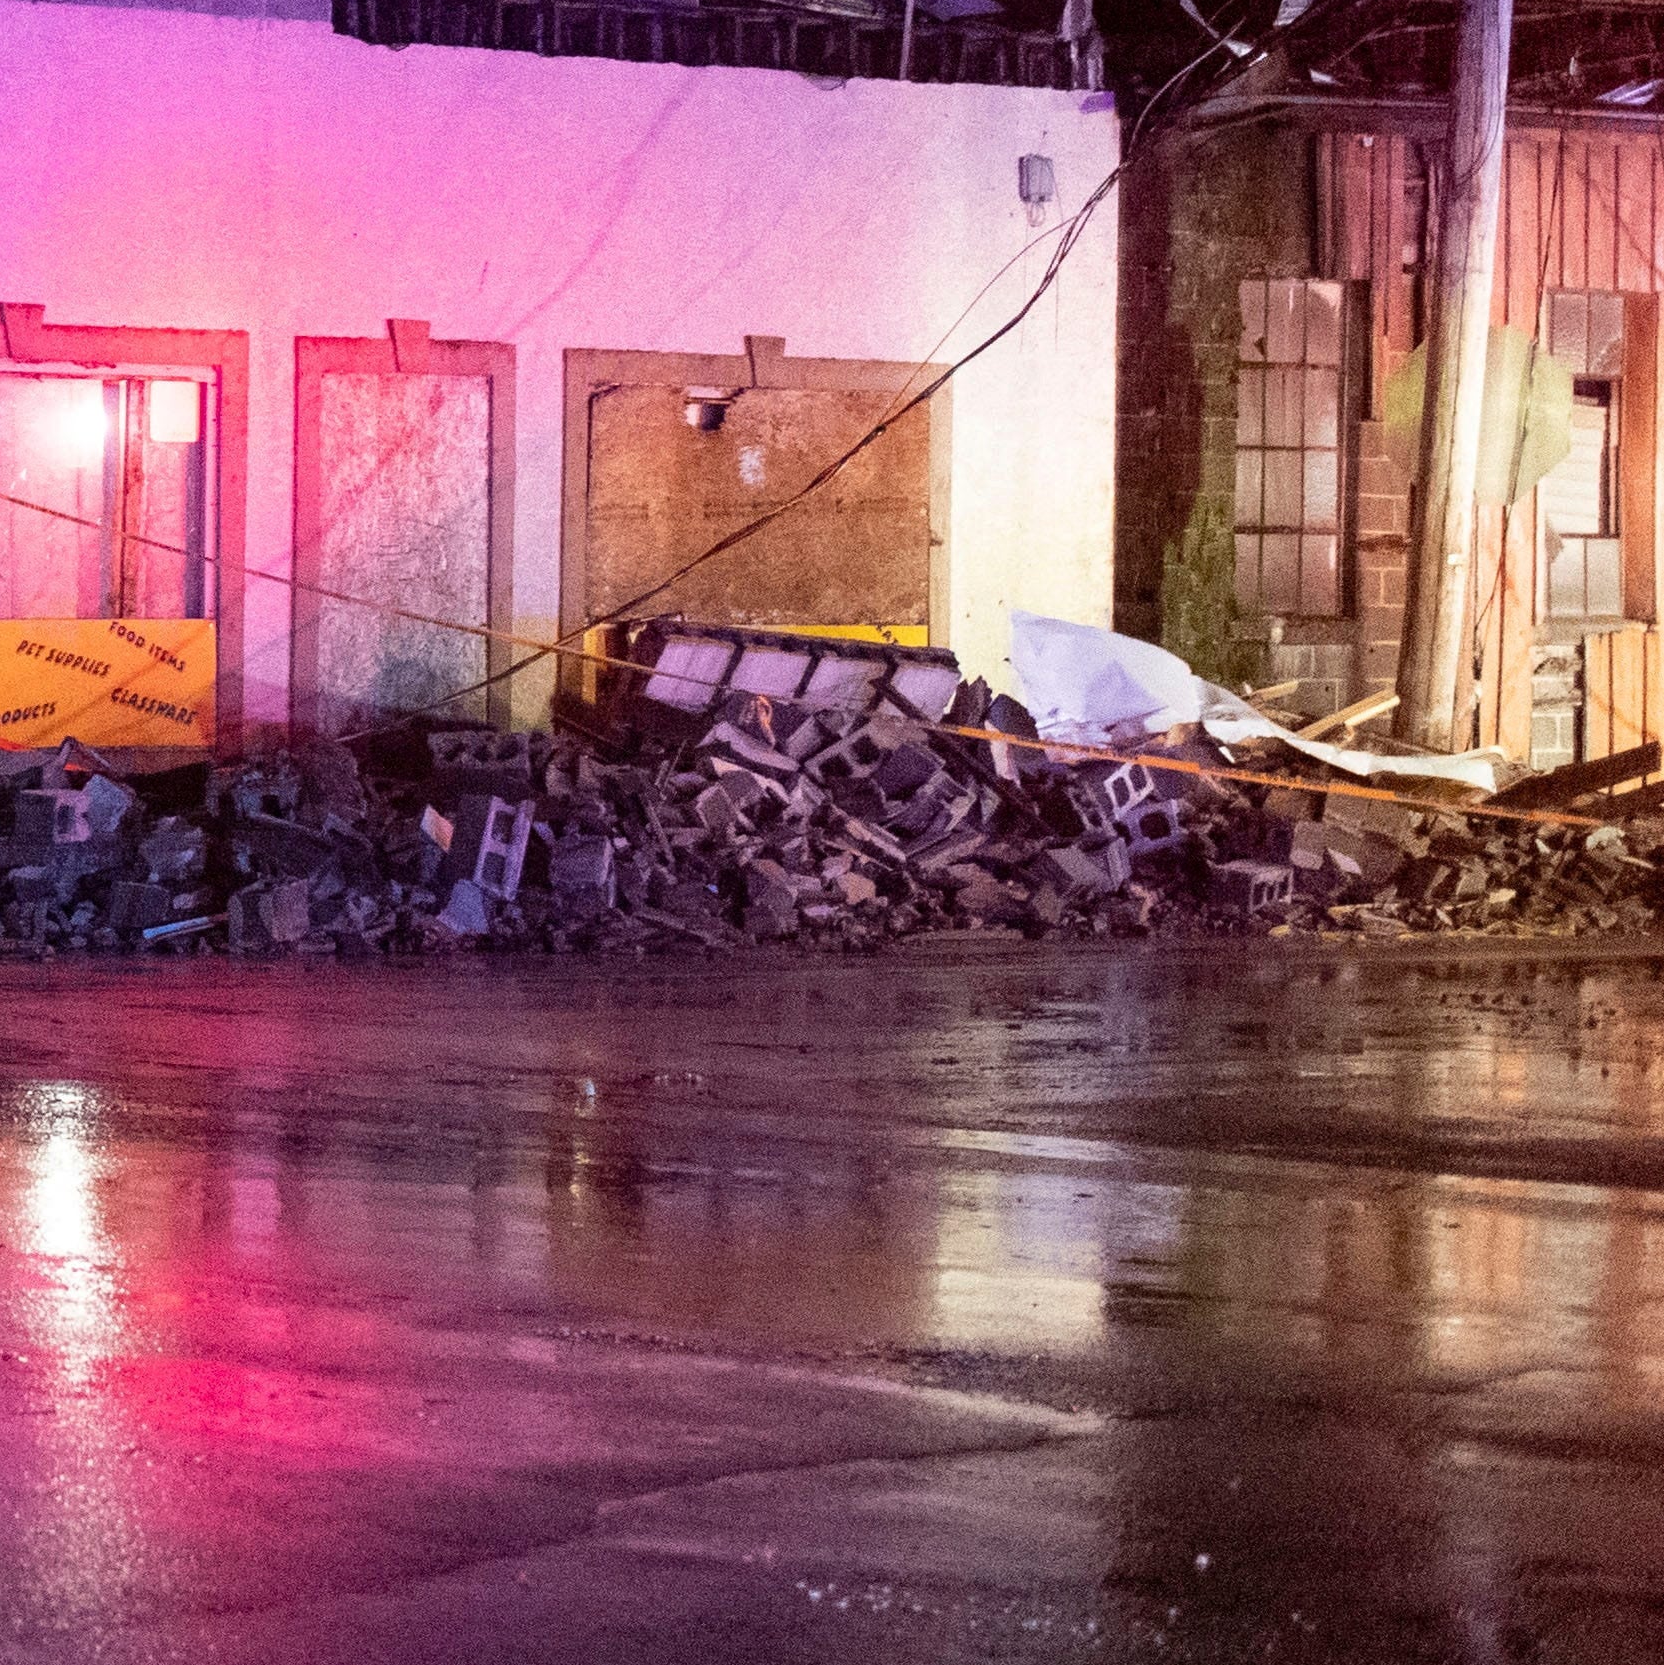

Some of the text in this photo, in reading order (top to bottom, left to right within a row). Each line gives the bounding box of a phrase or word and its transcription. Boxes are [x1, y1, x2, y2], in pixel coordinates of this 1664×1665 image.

[16, 639, 112, 678] PET SUPPLIES
[109, 621, 186, 672] FOOD ITEMS
[111, 687, 199, 726] GLASSWARE
